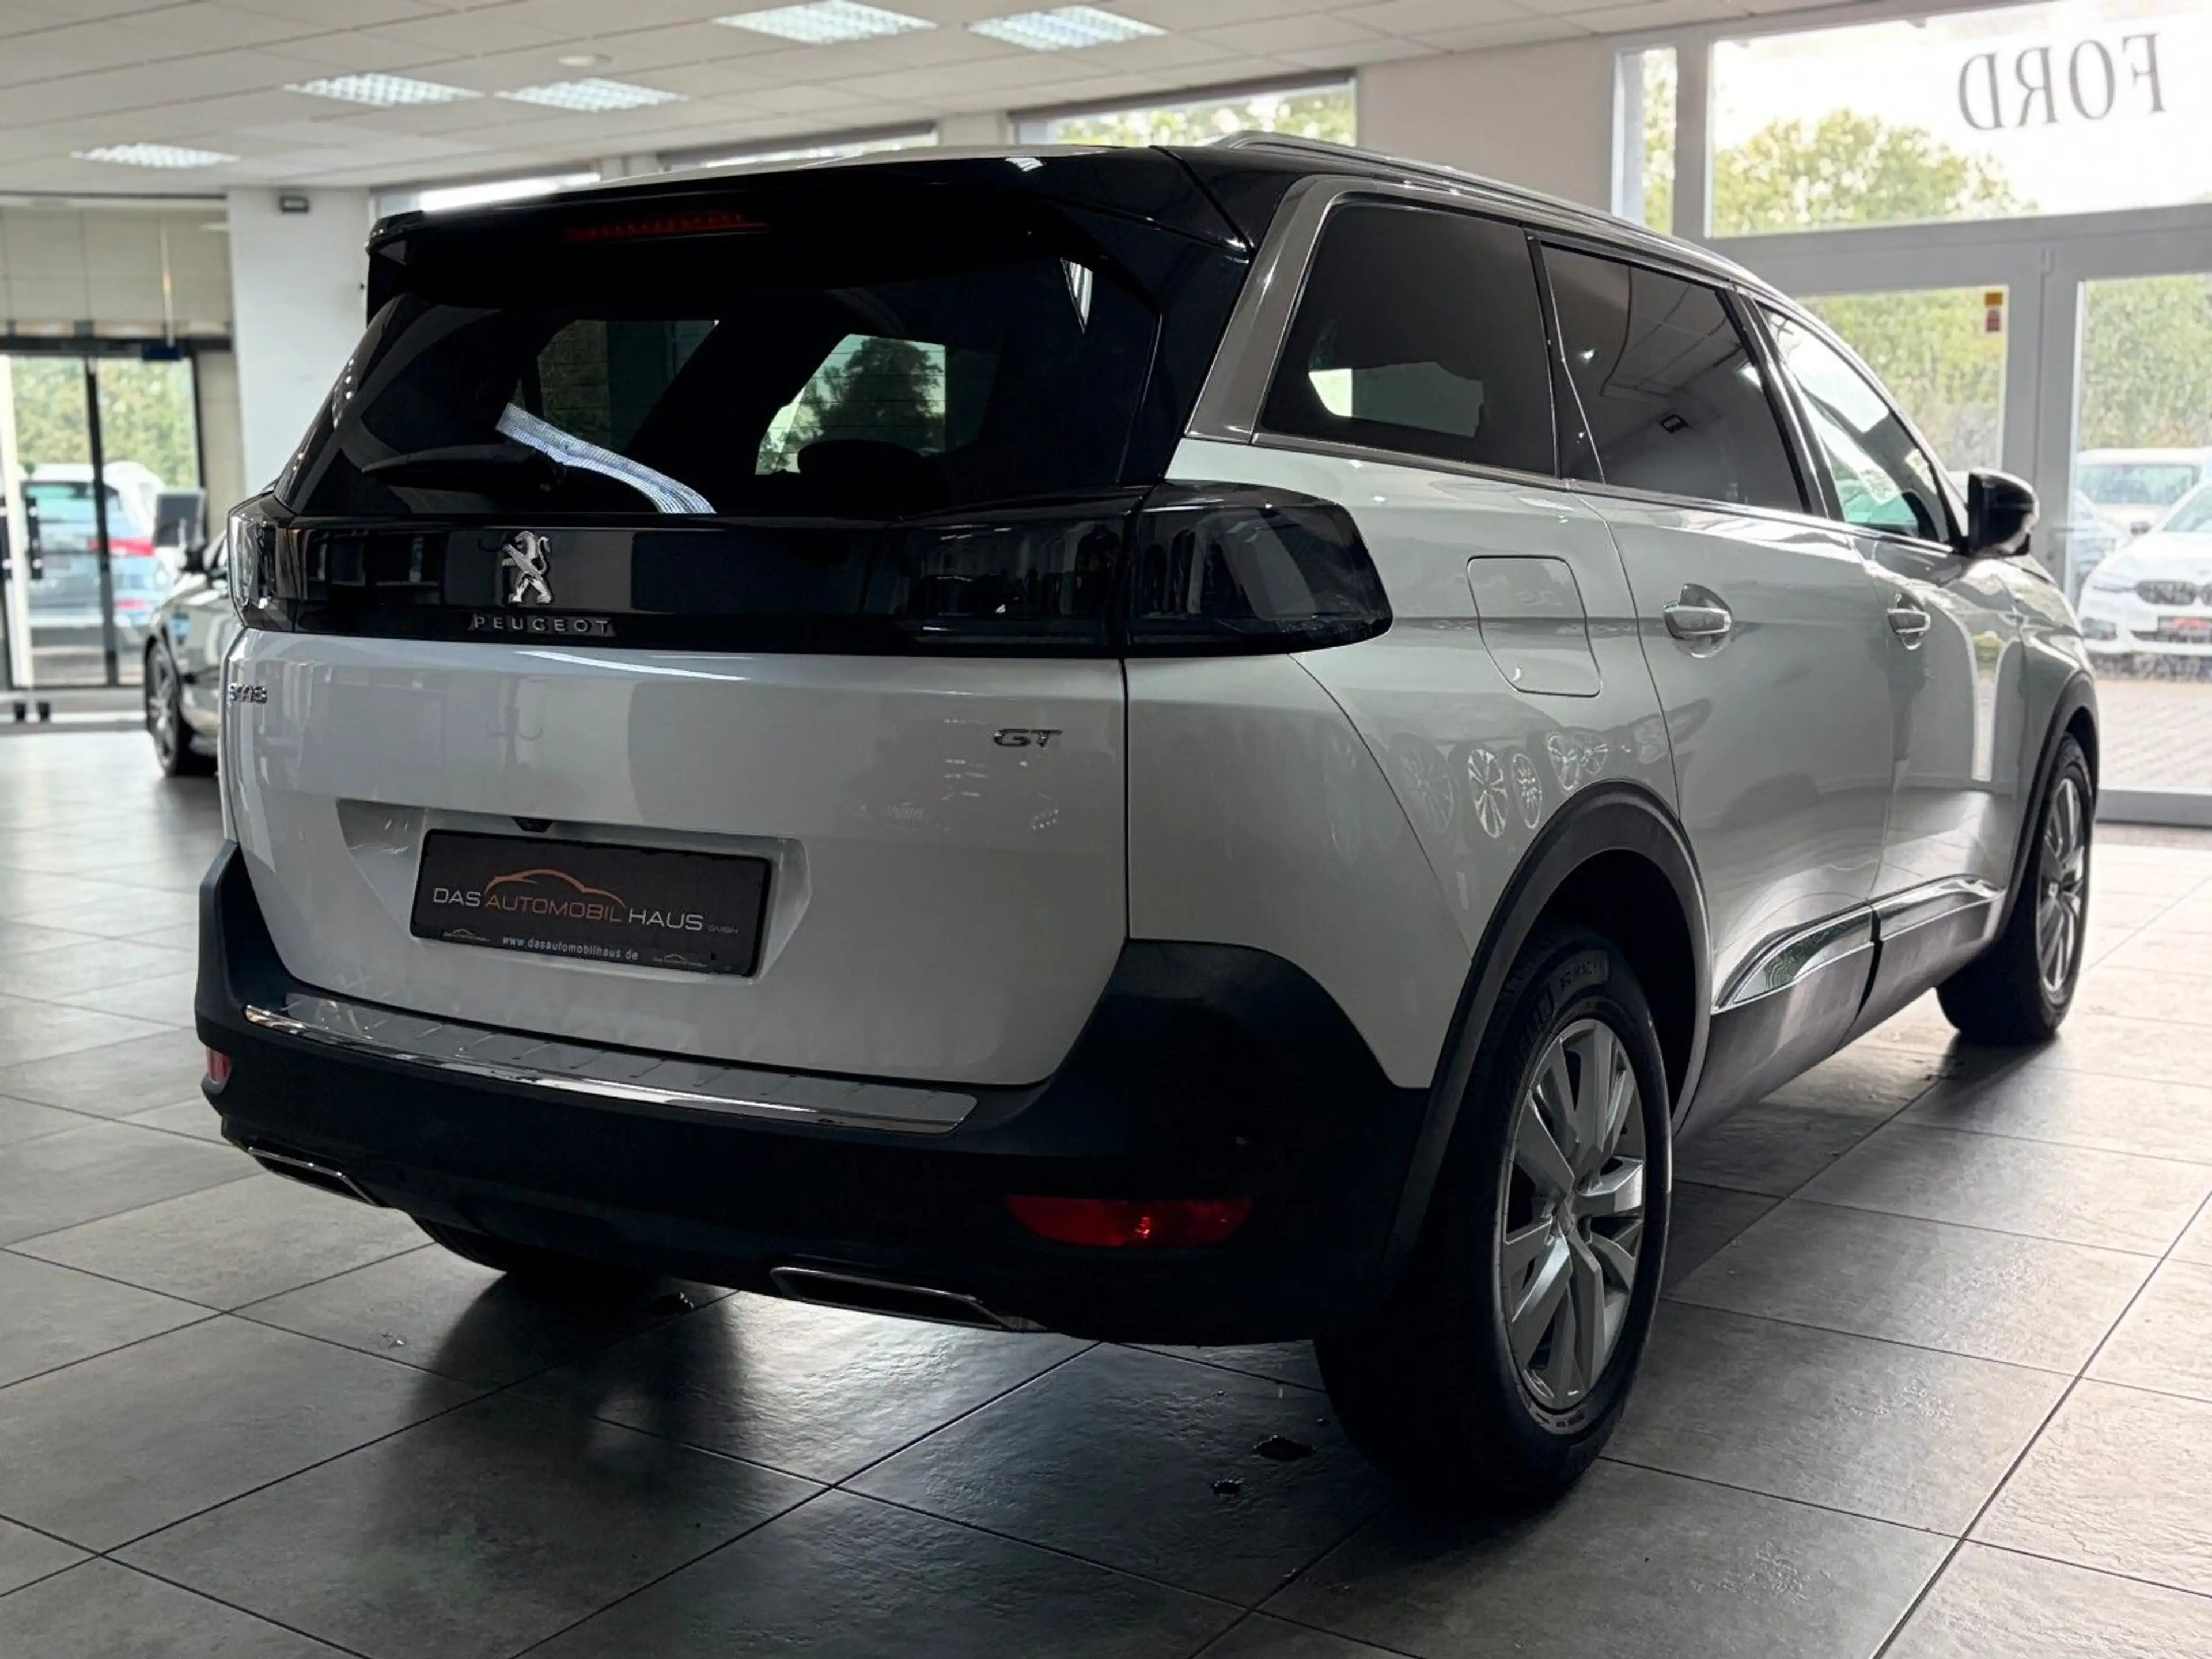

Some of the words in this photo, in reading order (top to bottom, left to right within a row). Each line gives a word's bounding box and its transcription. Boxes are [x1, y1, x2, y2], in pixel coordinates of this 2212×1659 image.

[473, 615, 609, 633] PEUGEOT
[993, 728, 1063, 748] GT
[433, 887, 482, 907] DAS
[484, 896, 622, 923] AUTOMOBIL
[628, 908, 704, 931] HAUS
